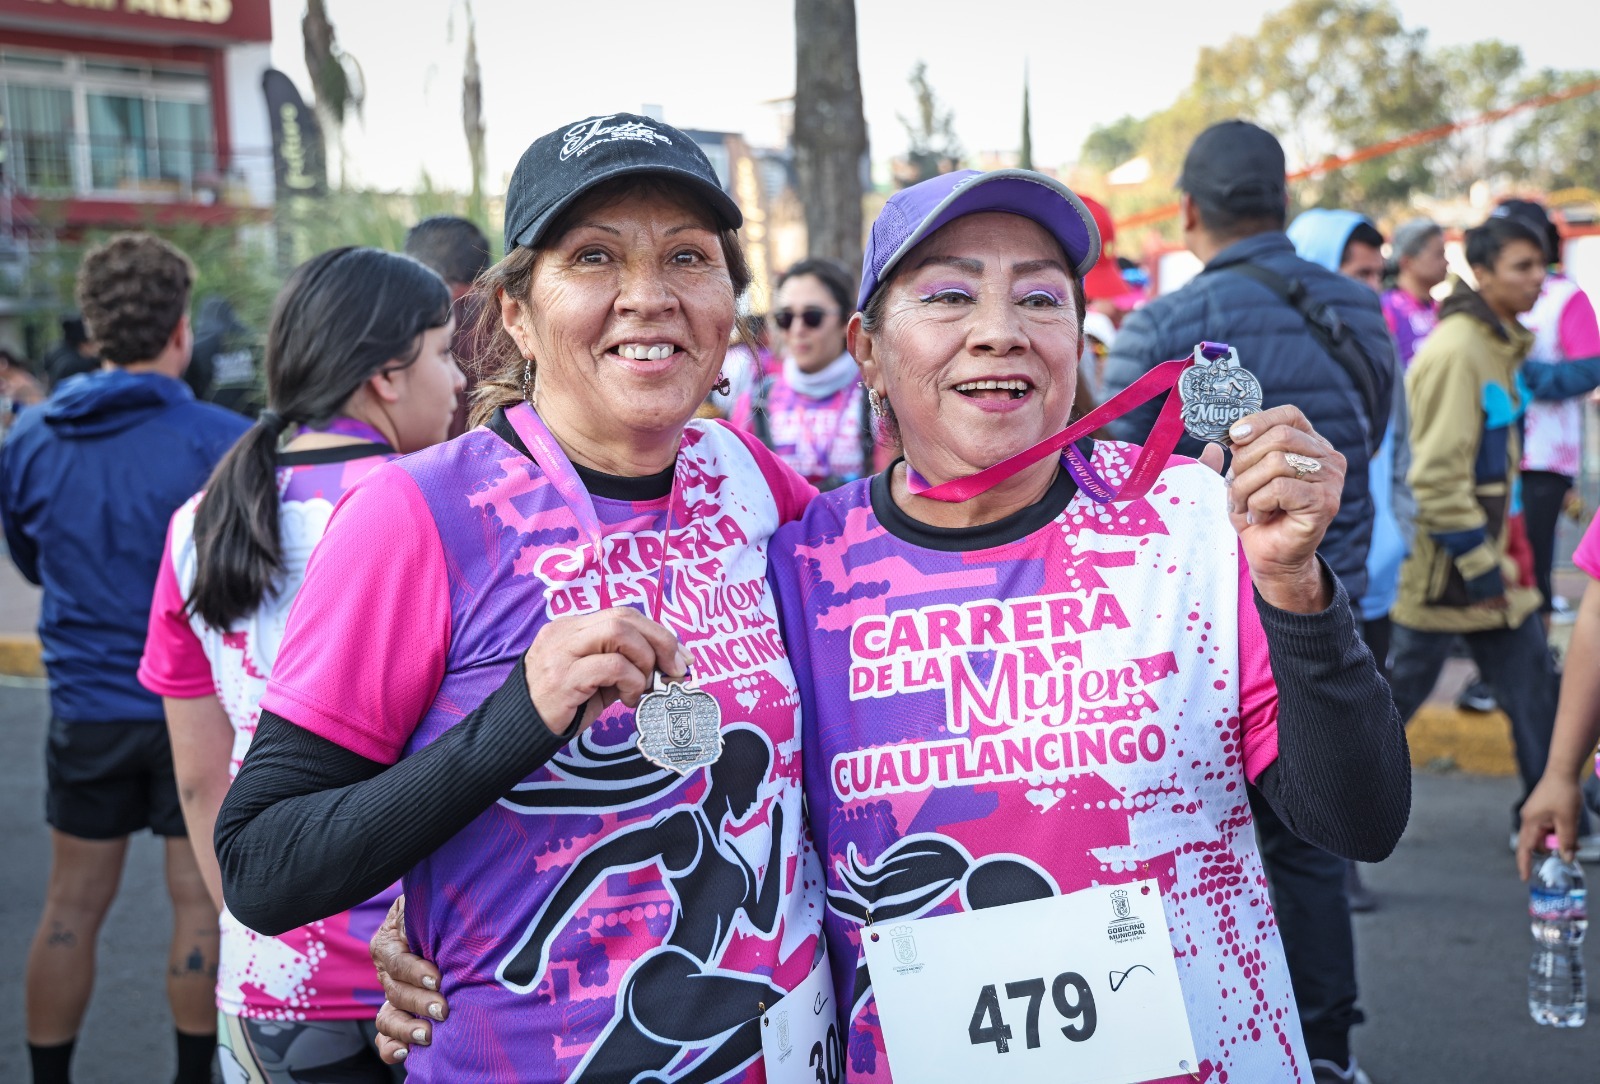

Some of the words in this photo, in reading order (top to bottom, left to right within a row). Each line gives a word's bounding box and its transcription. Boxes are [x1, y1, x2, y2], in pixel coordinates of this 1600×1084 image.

[1189, 403, 1249, 425] Mujer
[1061, 444, 1110, 501] CUAUTLANCING
[550, 586, 593, 616] DE
[852, 593, 1131, 660] CARRERA
[852, 666, 893, 694] DE
[903, 656, 944, 686] LA
[950, 652, 1141, 727] Mujer
[834, 724, 1167, 796] CUAUTLANCINGO
[1107, 923, 1145, 935] GOBIERNO
[1108, 930, 1146, 941] MUNICIPAL
[968, 972, 1098, 1054] 479
[809, 1023, 846, 1084] 30
